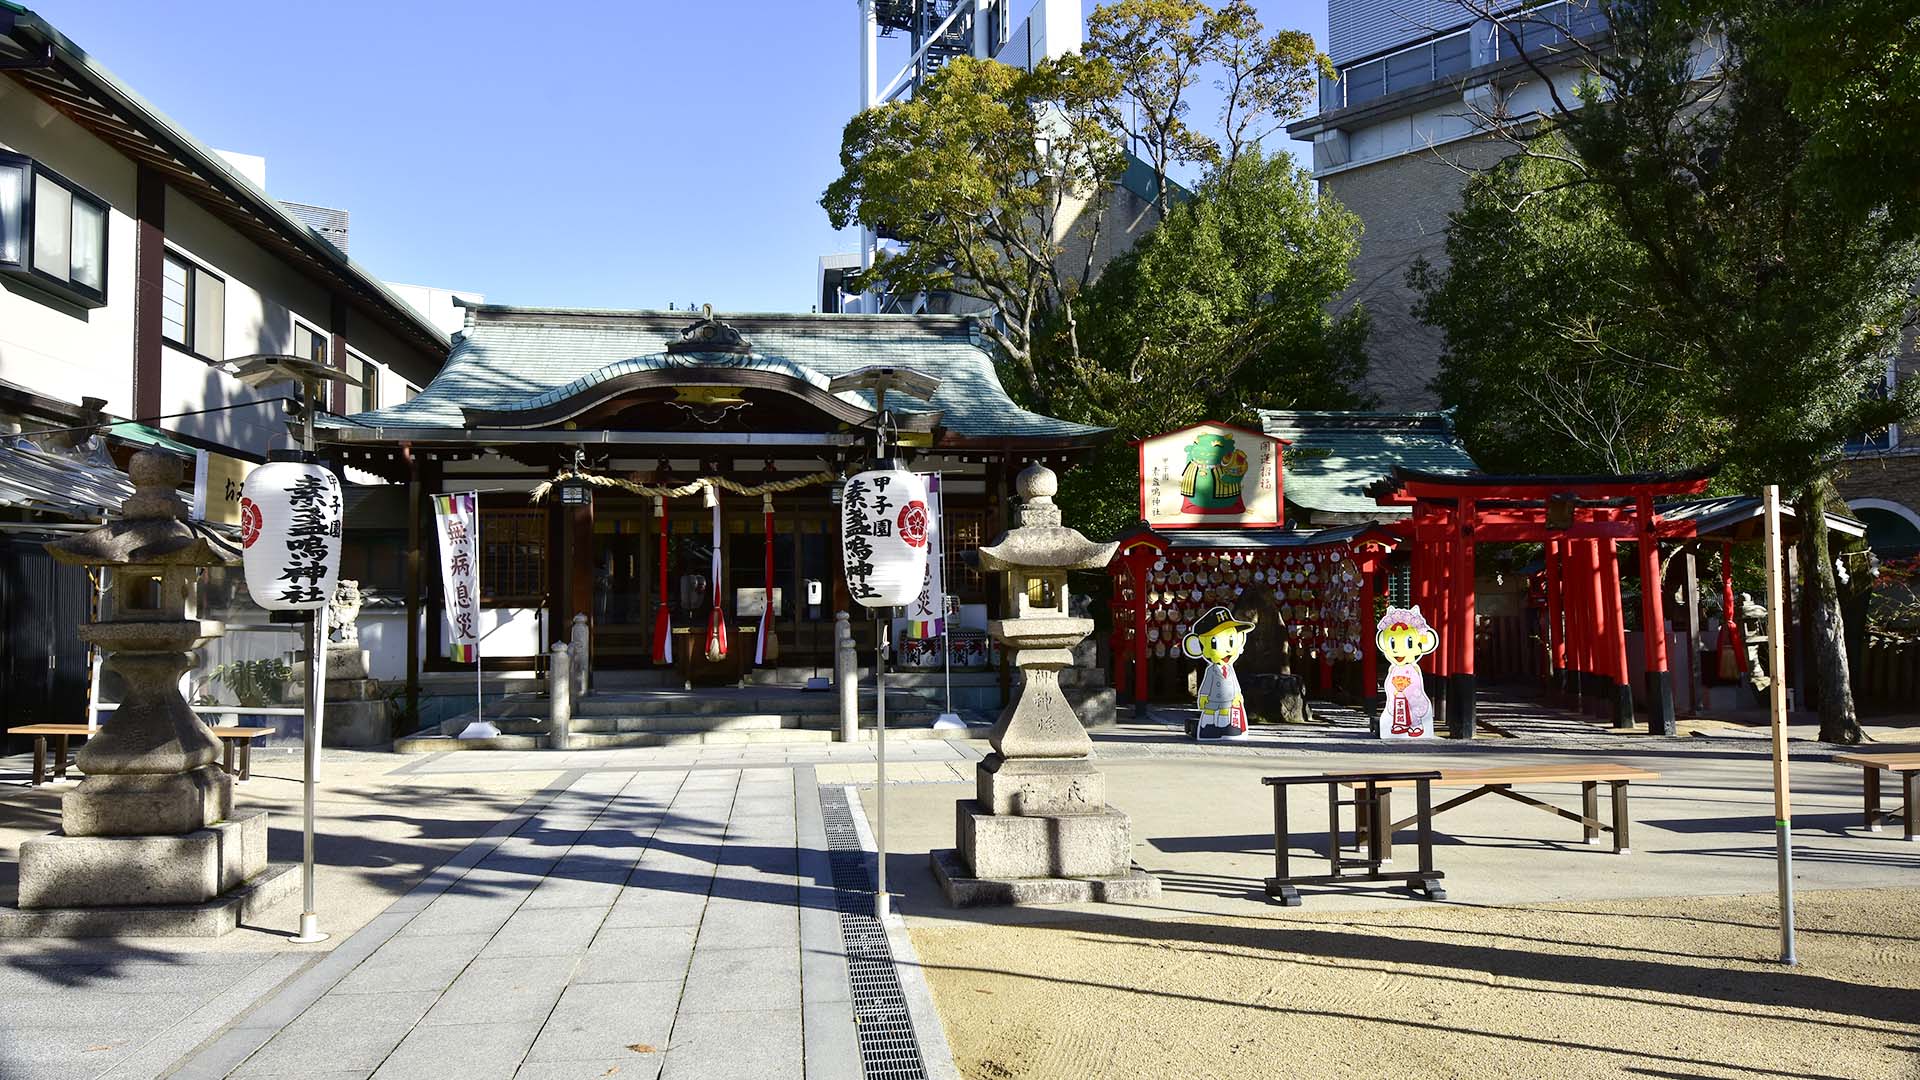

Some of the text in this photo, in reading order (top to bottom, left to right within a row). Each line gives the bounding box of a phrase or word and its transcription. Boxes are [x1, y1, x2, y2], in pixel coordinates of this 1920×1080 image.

[870, 476, 893, 538] 甲子園
[446, 519, 477, 640] 無病息災
